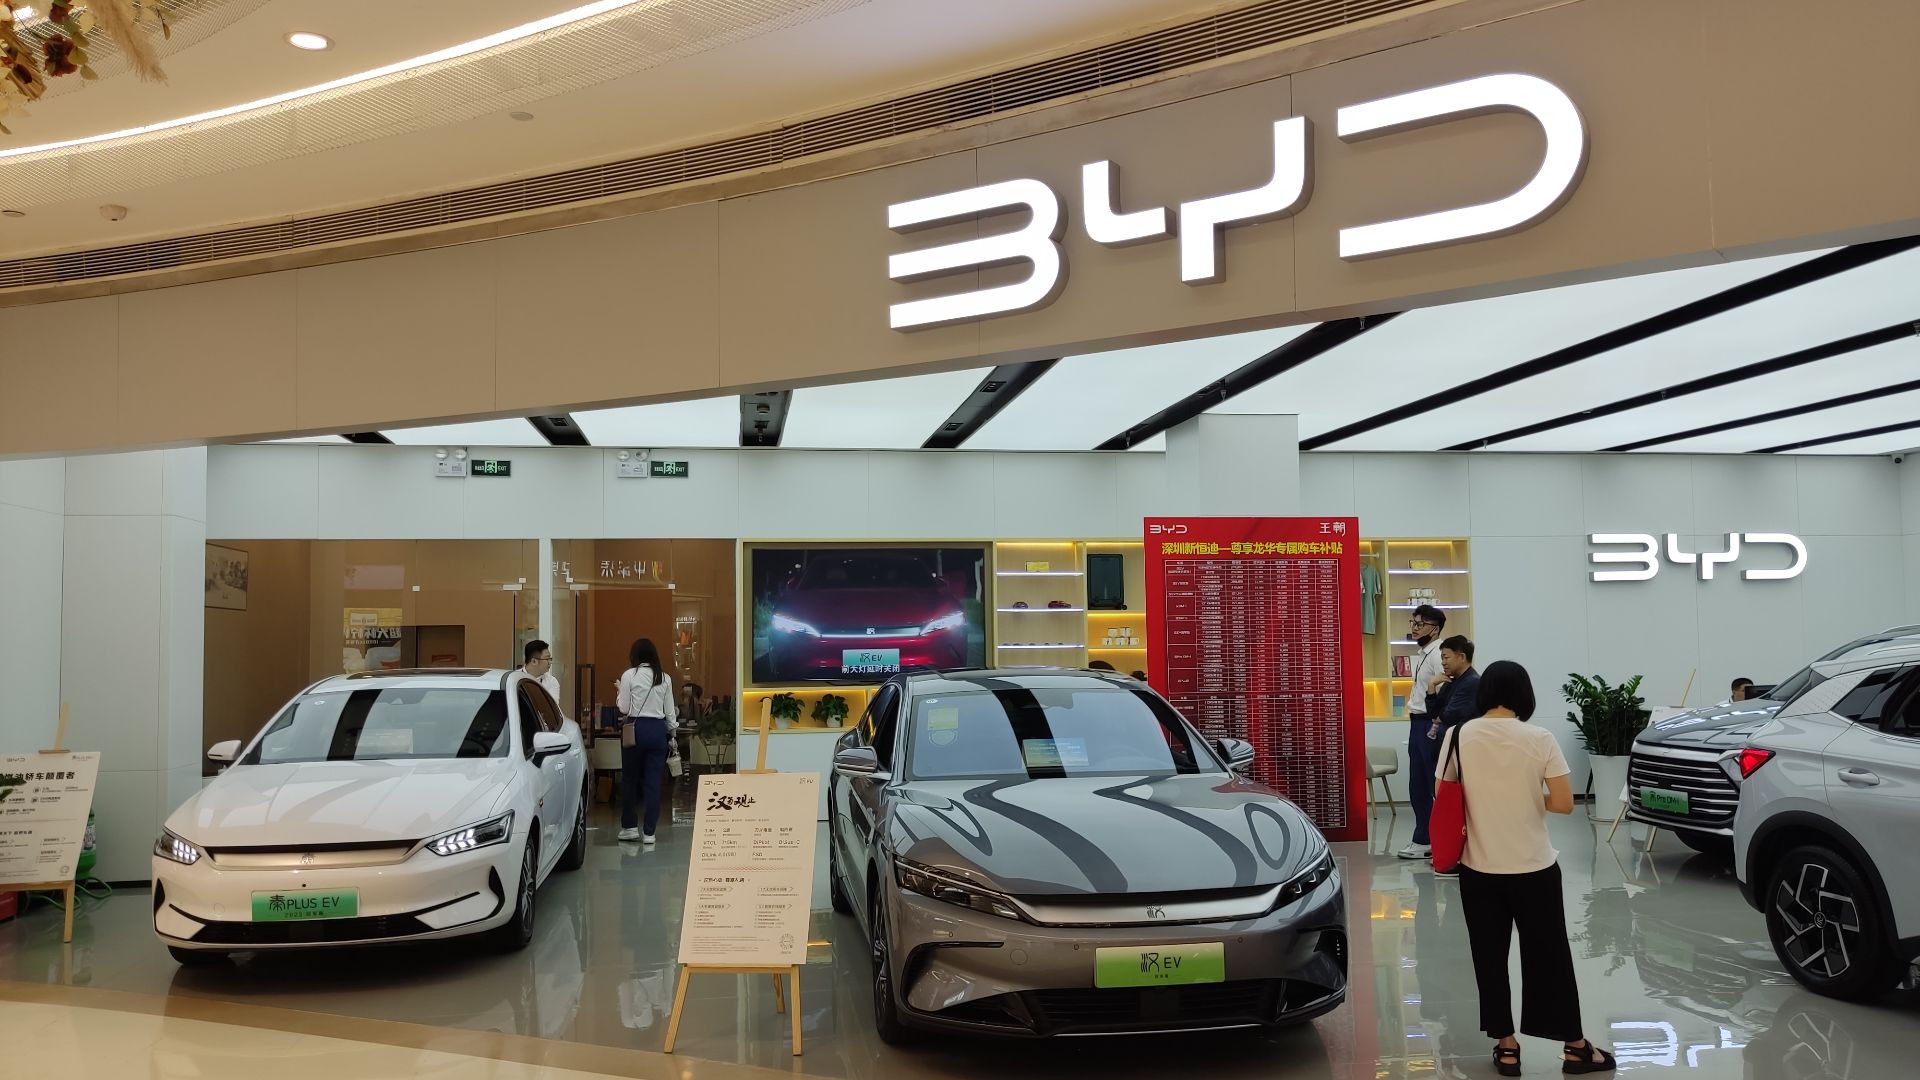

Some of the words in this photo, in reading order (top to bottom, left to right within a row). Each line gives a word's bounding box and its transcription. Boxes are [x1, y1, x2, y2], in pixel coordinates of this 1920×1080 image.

[888, 73, 1588, 331] BYD
[1149, 525, 1188, 534] BYD
[1319, 522, 1346, 536] 王朝
[1588, 532, 1808, 582] BYD
[322, 896, 340, 908] EV
[1163, 956, 1182, 969] EV
